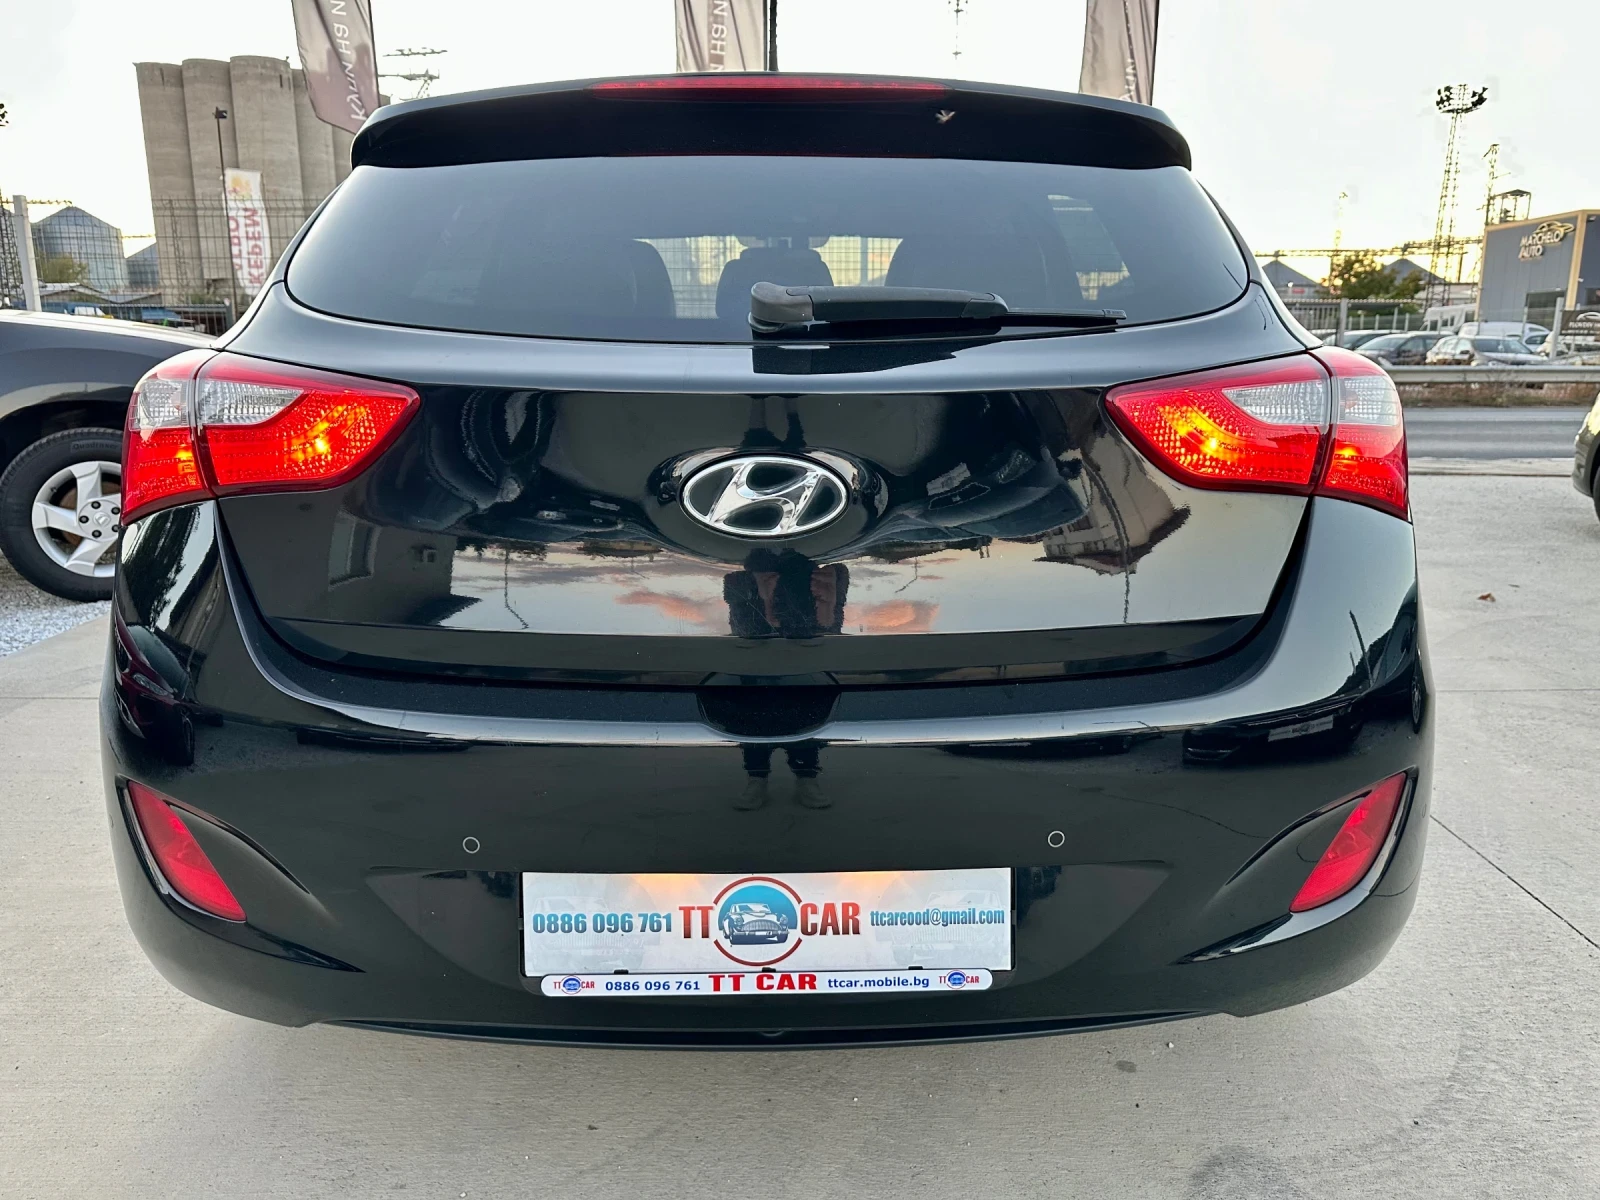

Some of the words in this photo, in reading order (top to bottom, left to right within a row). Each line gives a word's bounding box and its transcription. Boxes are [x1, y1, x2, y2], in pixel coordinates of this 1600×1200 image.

[1518, 244, 1543, 259] AUTO
[532, 913, 587, 933] 0886
[592, 913, 634, 933] 096
[638, 912, 672, 933] 761
[679, 905, 714, 939] TT
[800, 902, 861, 936] CAR
[581, 981, 595, 989] CAR
[605, 981, 640, 991] 0886
[644, 981, 671, 991] 096
[675, 981, 700, 990] 761
[708, 974, 745, 992] TT
[756, 973, 817, 991] CAR
[828, 976, 930, 988] ttcar.mobile.bg
[966, 975, 980, 984] CAR
